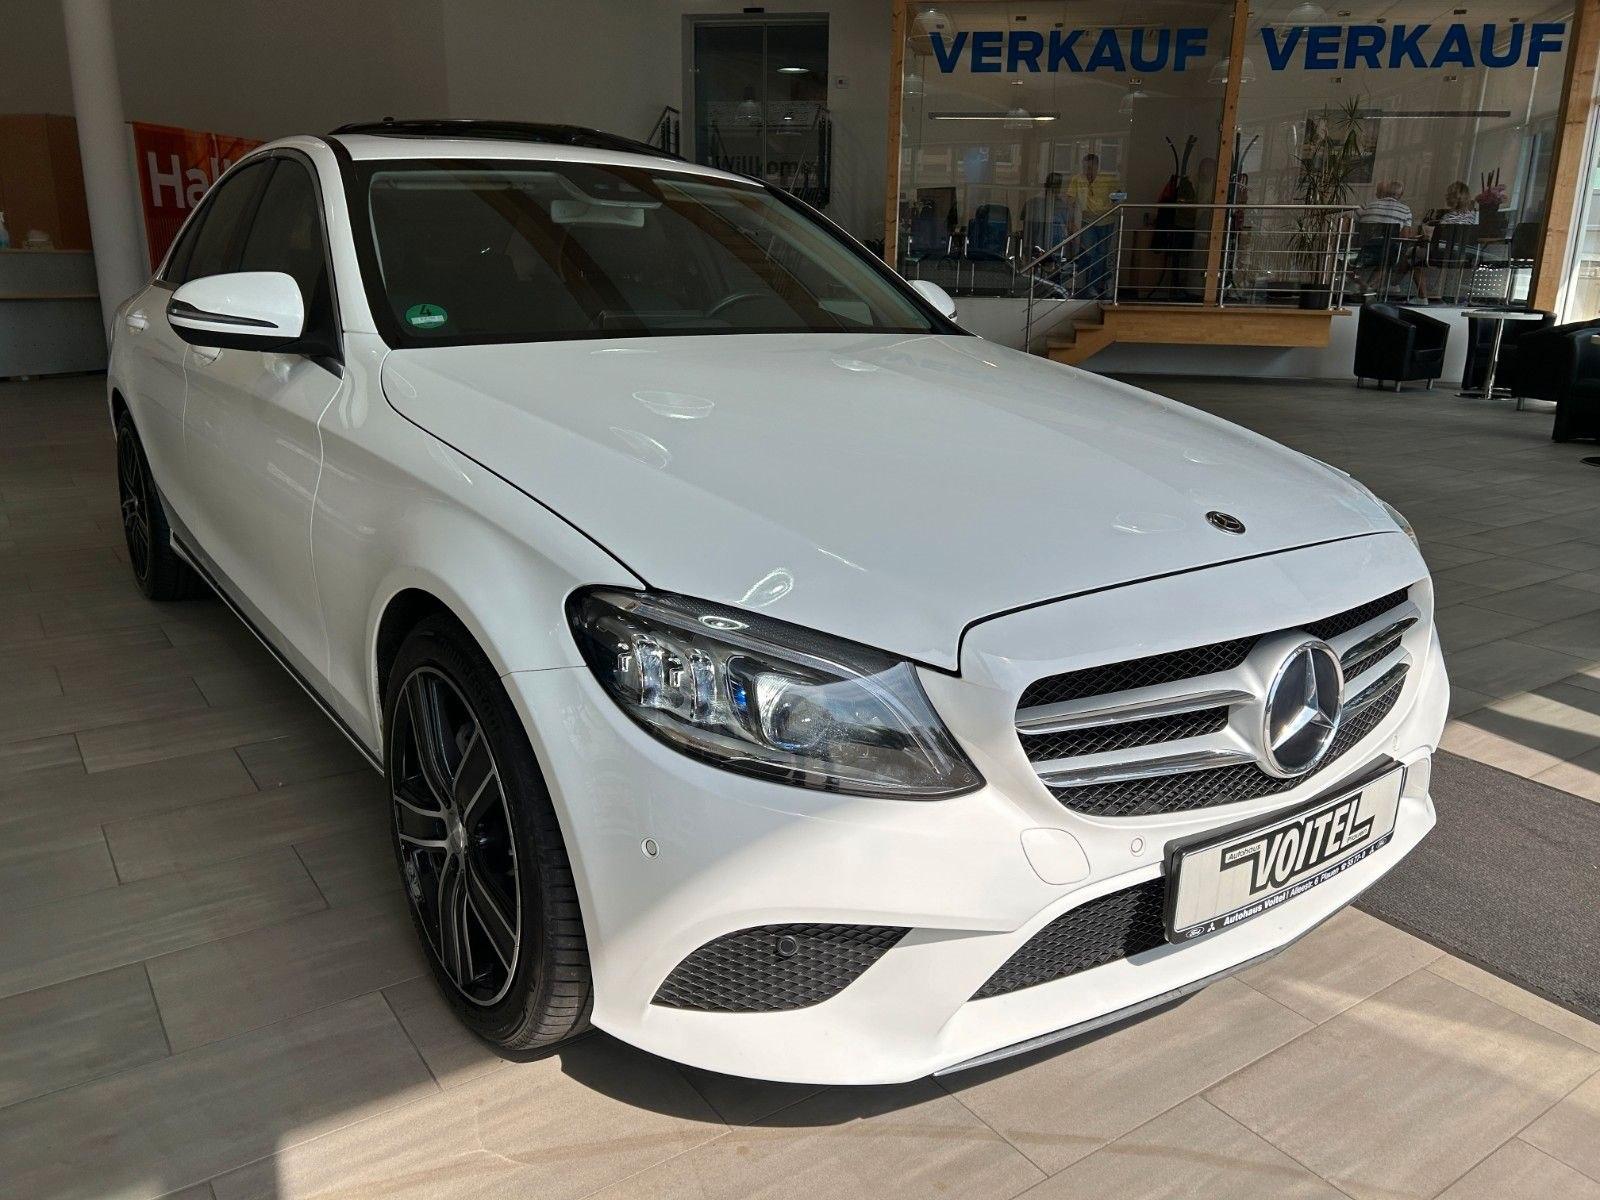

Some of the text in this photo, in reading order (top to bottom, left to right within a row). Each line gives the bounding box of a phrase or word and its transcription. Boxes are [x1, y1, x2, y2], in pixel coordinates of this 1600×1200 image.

[929, 28, 1208, 73] VERKAUF
[1261, 24, 1566, 70] VERKAUF
[147, 151, 234, 209] Ha
[419, 304, 432, 317] 4
[1226, 844, 1261, 861] Autohaus
[1253, 796, 1372, 889] VOITEL
[1223, 905, 1263, 926] Autohaus
[1263, 892, 1286, 909] Voitel
